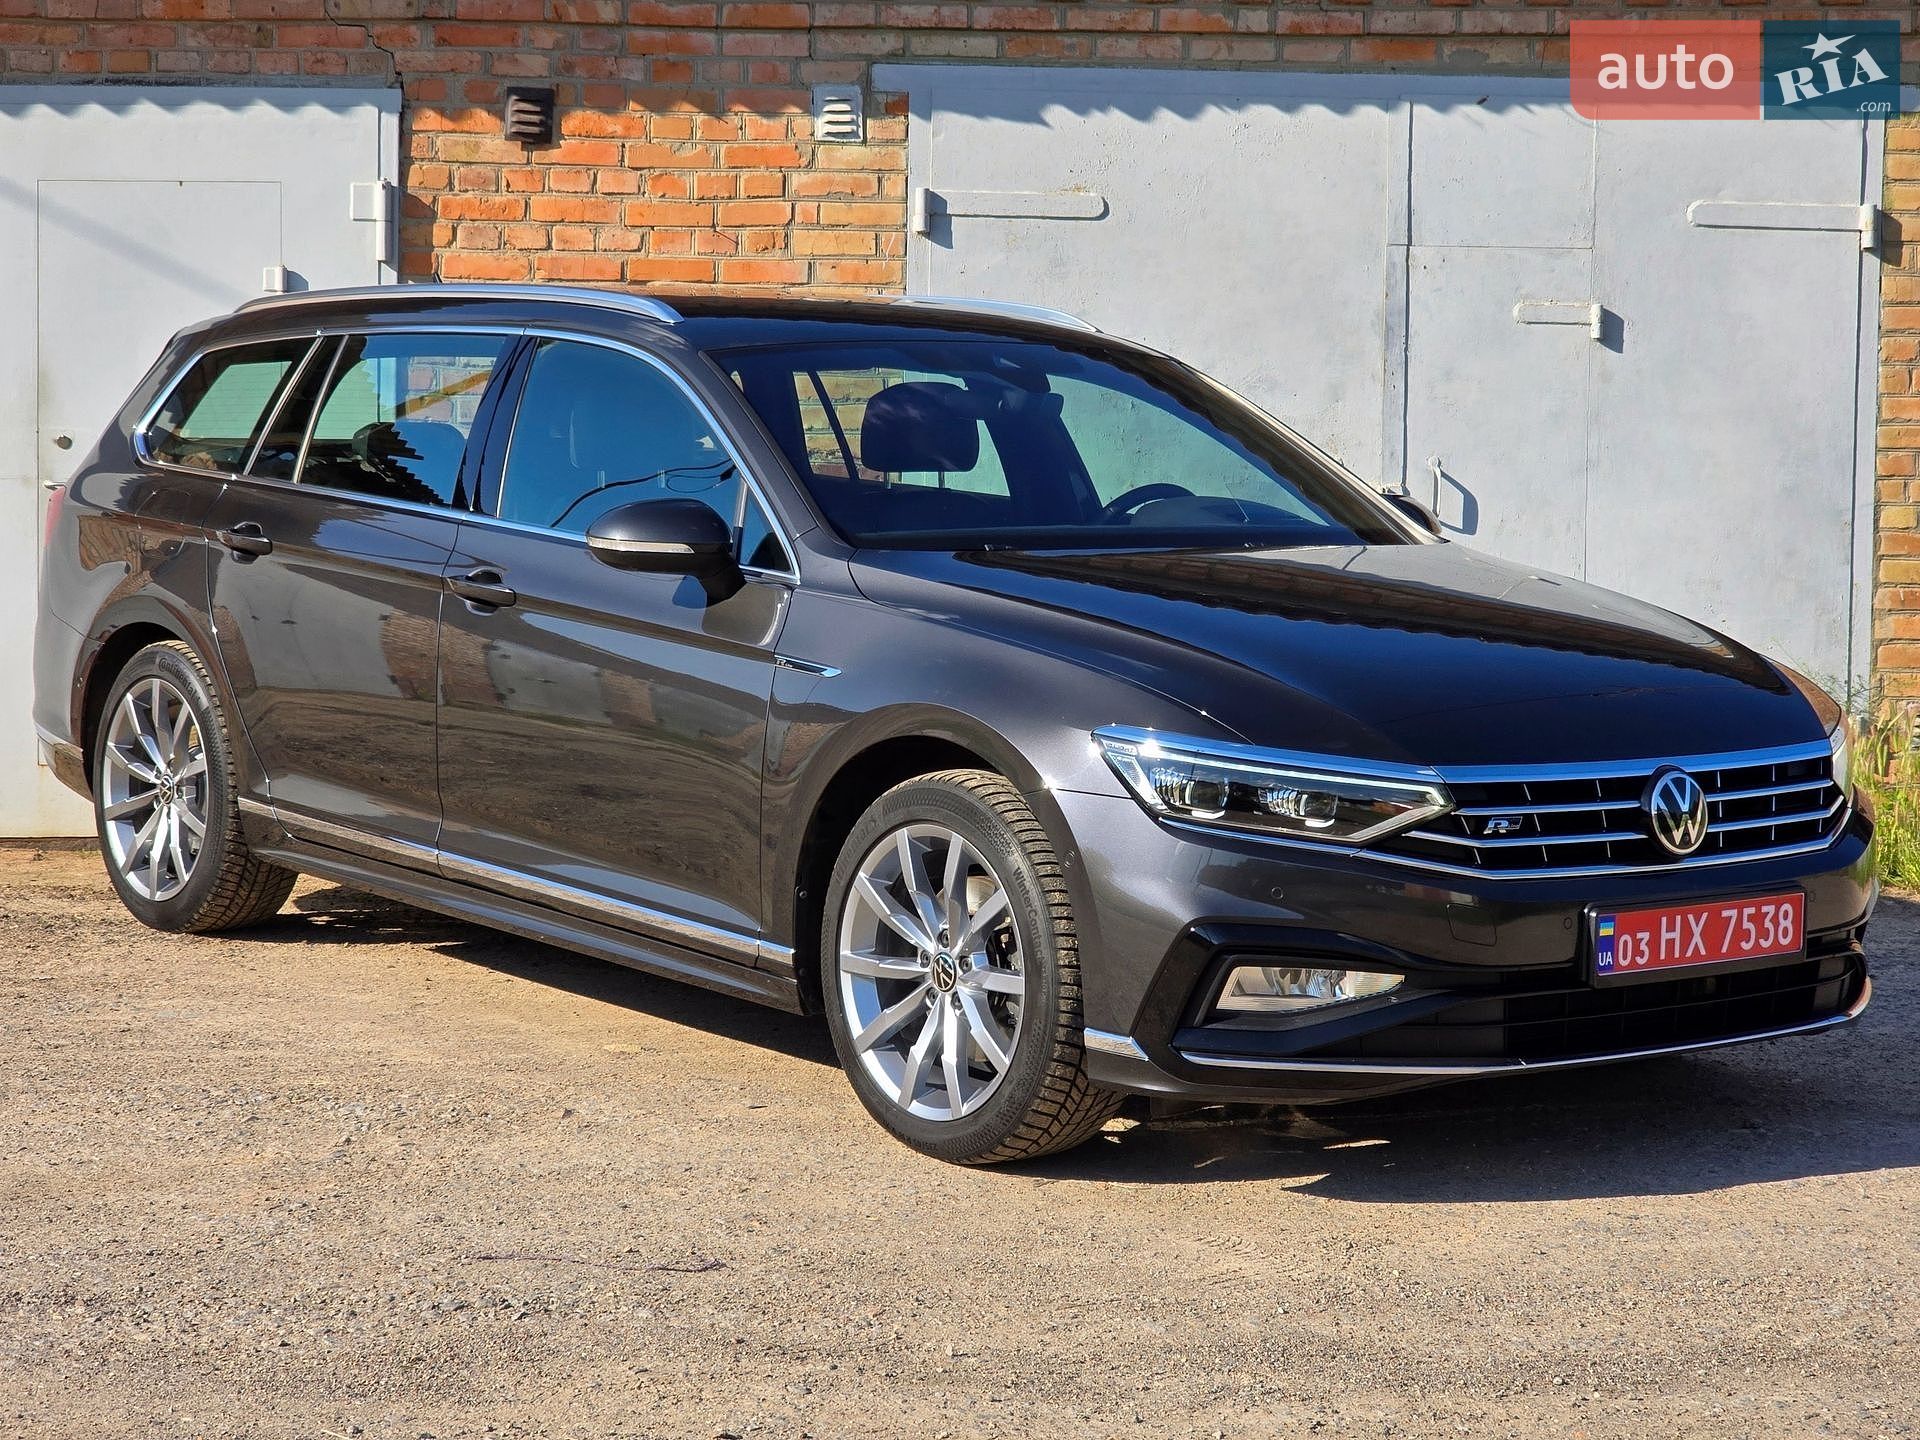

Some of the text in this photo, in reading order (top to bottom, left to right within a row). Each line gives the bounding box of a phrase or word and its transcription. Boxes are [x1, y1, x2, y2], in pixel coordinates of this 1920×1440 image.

[1618, 903, 1794, 967] 03 HX 7538
[1598, 951, 1613, 967] UA
